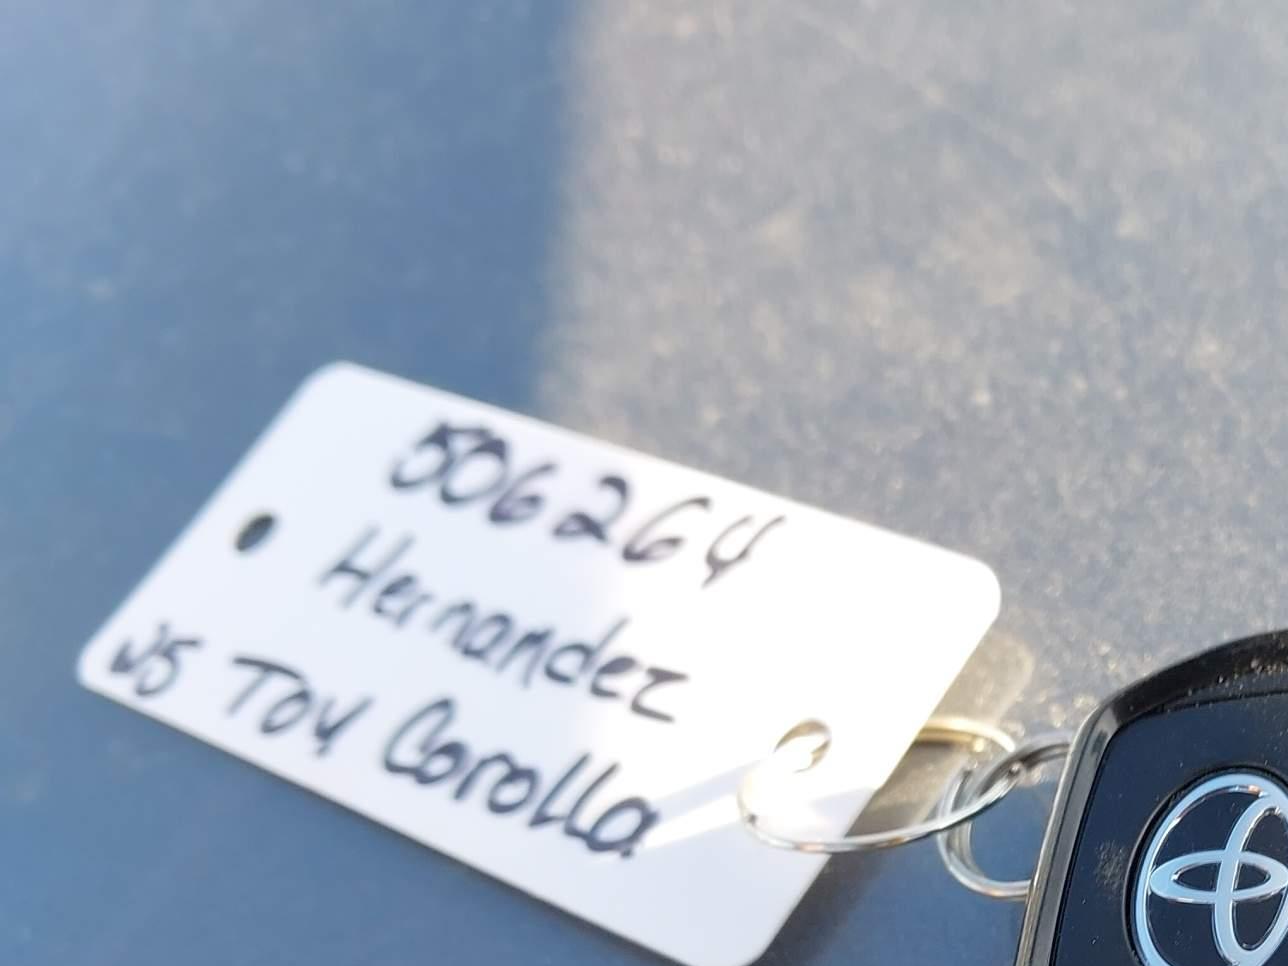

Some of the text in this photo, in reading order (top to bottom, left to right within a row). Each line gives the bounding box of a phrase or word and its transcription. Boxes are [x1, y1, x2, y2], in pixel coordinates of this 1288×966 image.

[390, 422, 786, 588] 506264
[317, 524, 690, 723] Hernandez
[383, 696, 660, 858] Corolla
